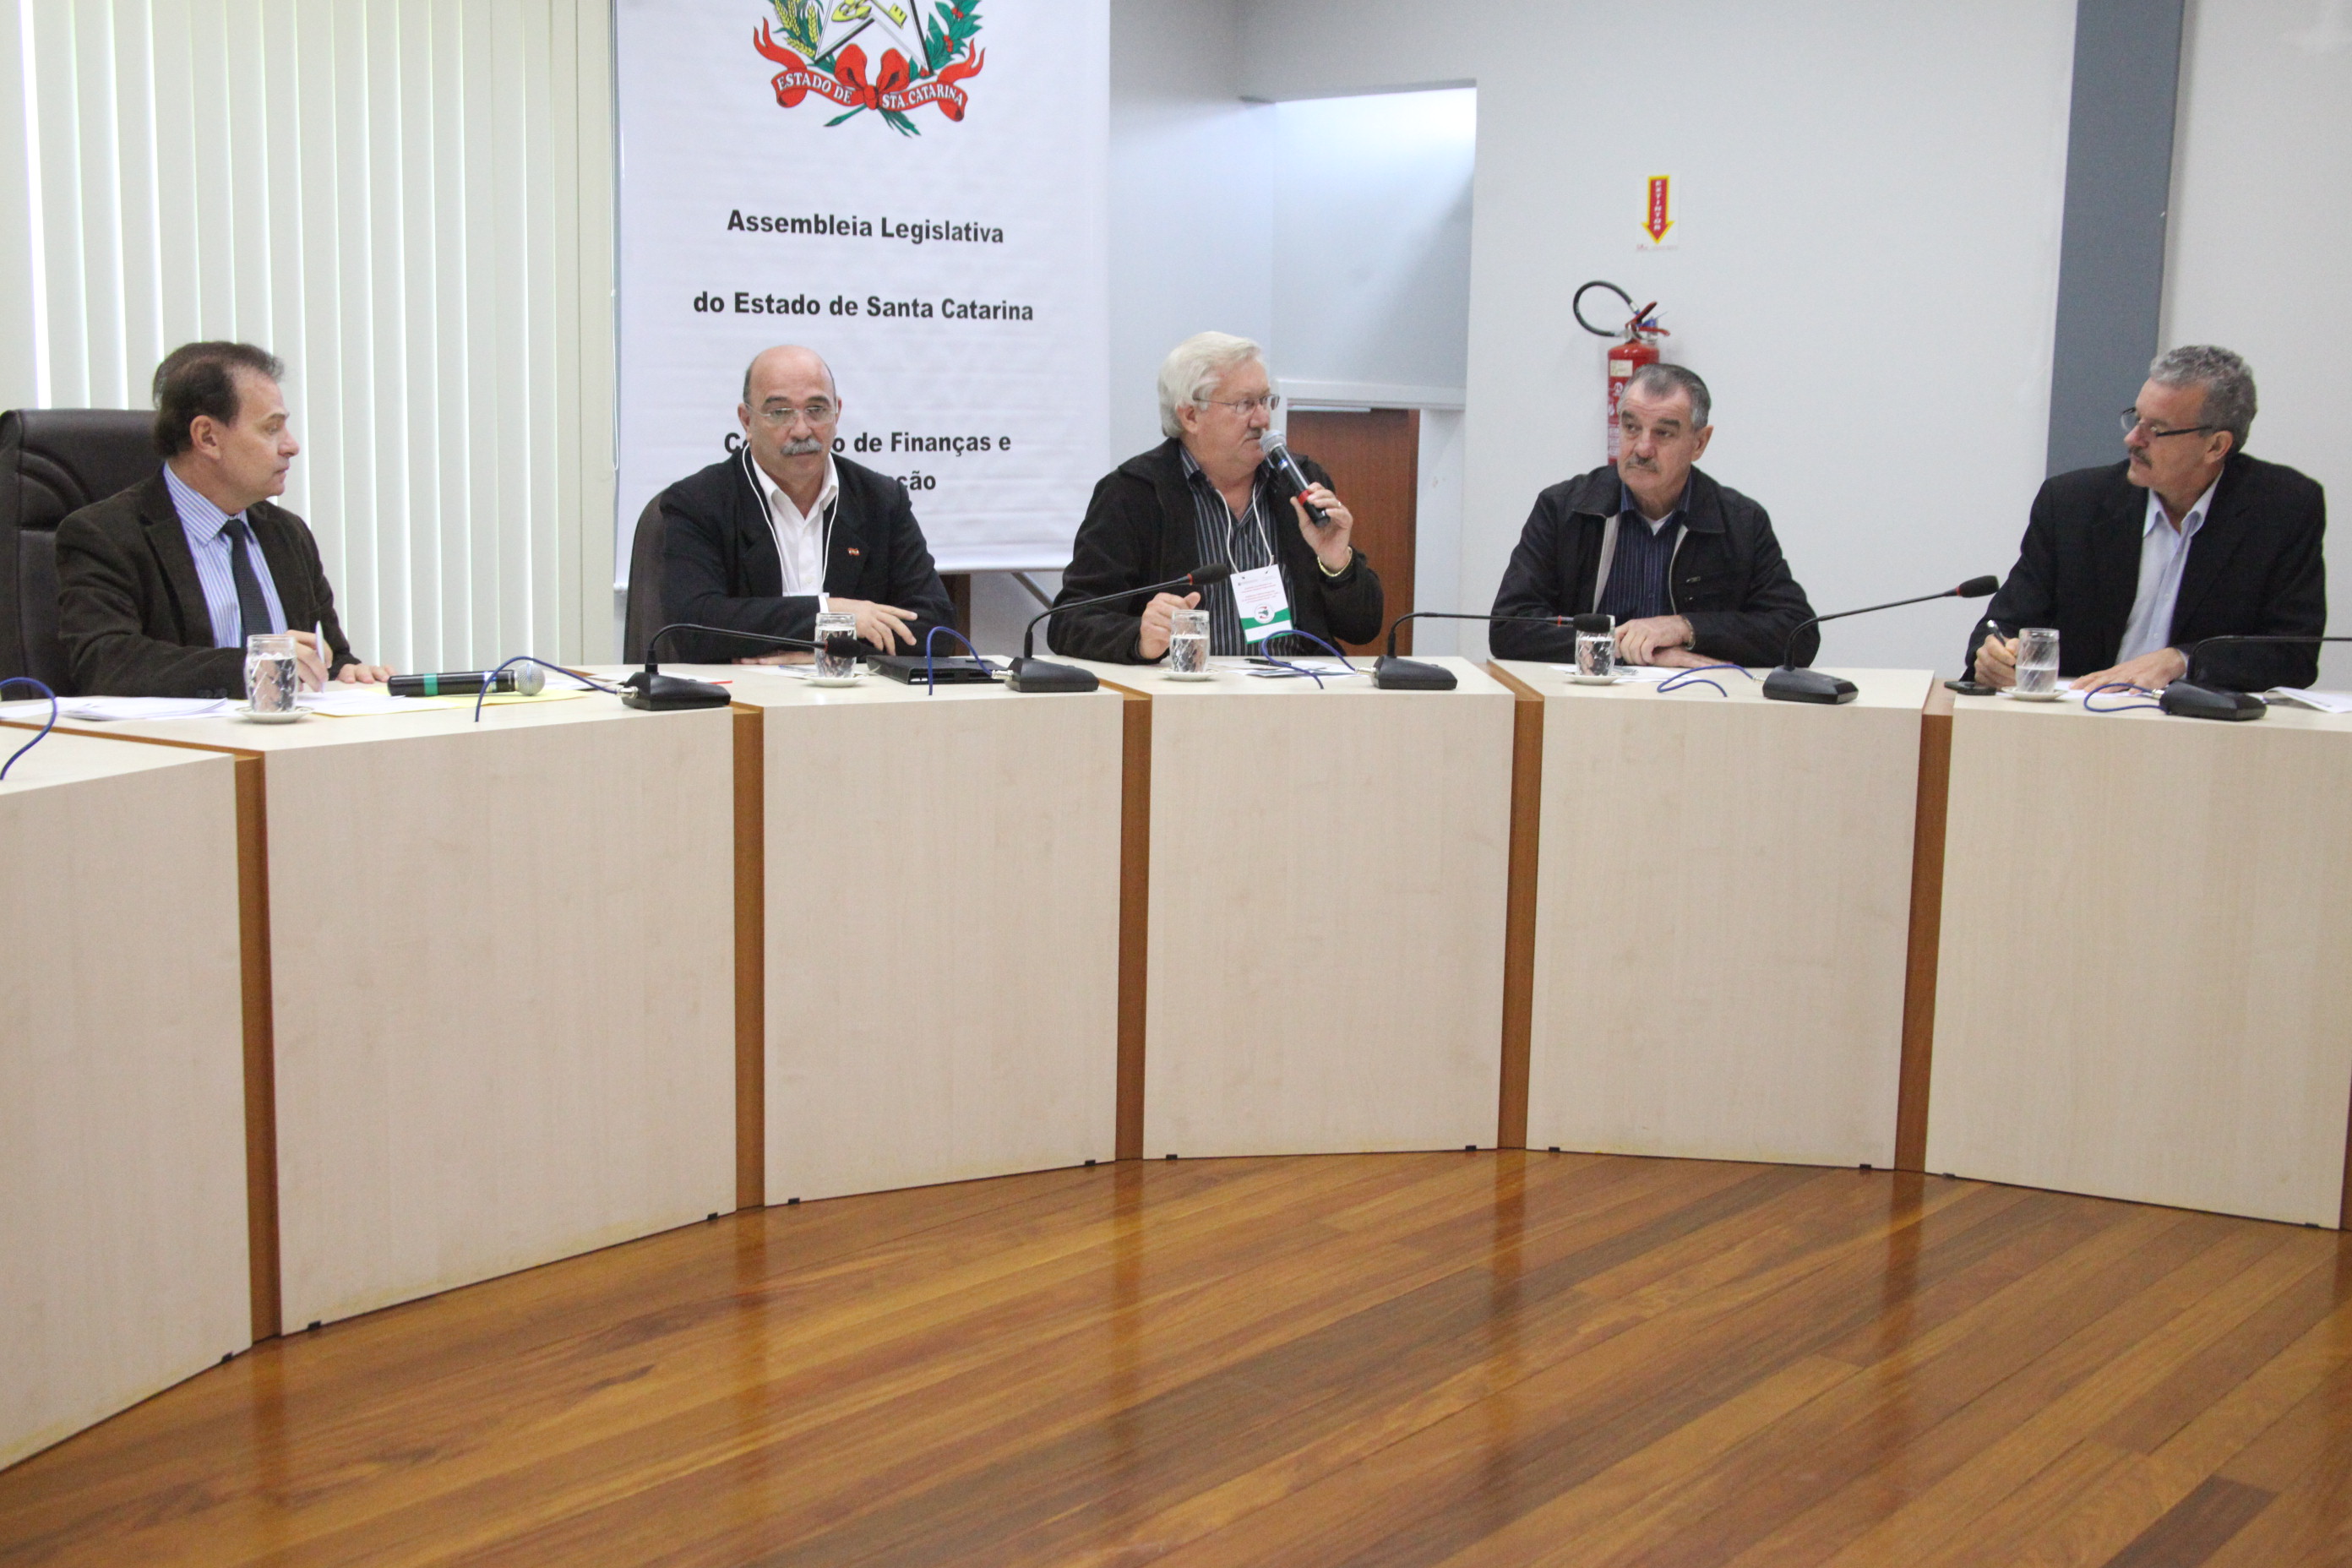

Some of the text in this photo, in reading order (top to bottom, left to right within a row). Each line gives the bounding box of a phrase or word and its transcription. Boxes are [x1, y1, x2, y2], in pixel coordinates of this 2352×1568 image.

[777, 73, 831, 93] ESTADO
[834, 86, 852, 103] DE
[908, 84, 964, 106] CATARINA
[727, 210, 1004, 244] Assembleia Legislativa
[693, 291, 1033, 321] do Estado de Santa Catarina
[853, 432, 883, 452] de
[891, 432, 991, 457] Finanças
[999, 436, 1011, 451] e
